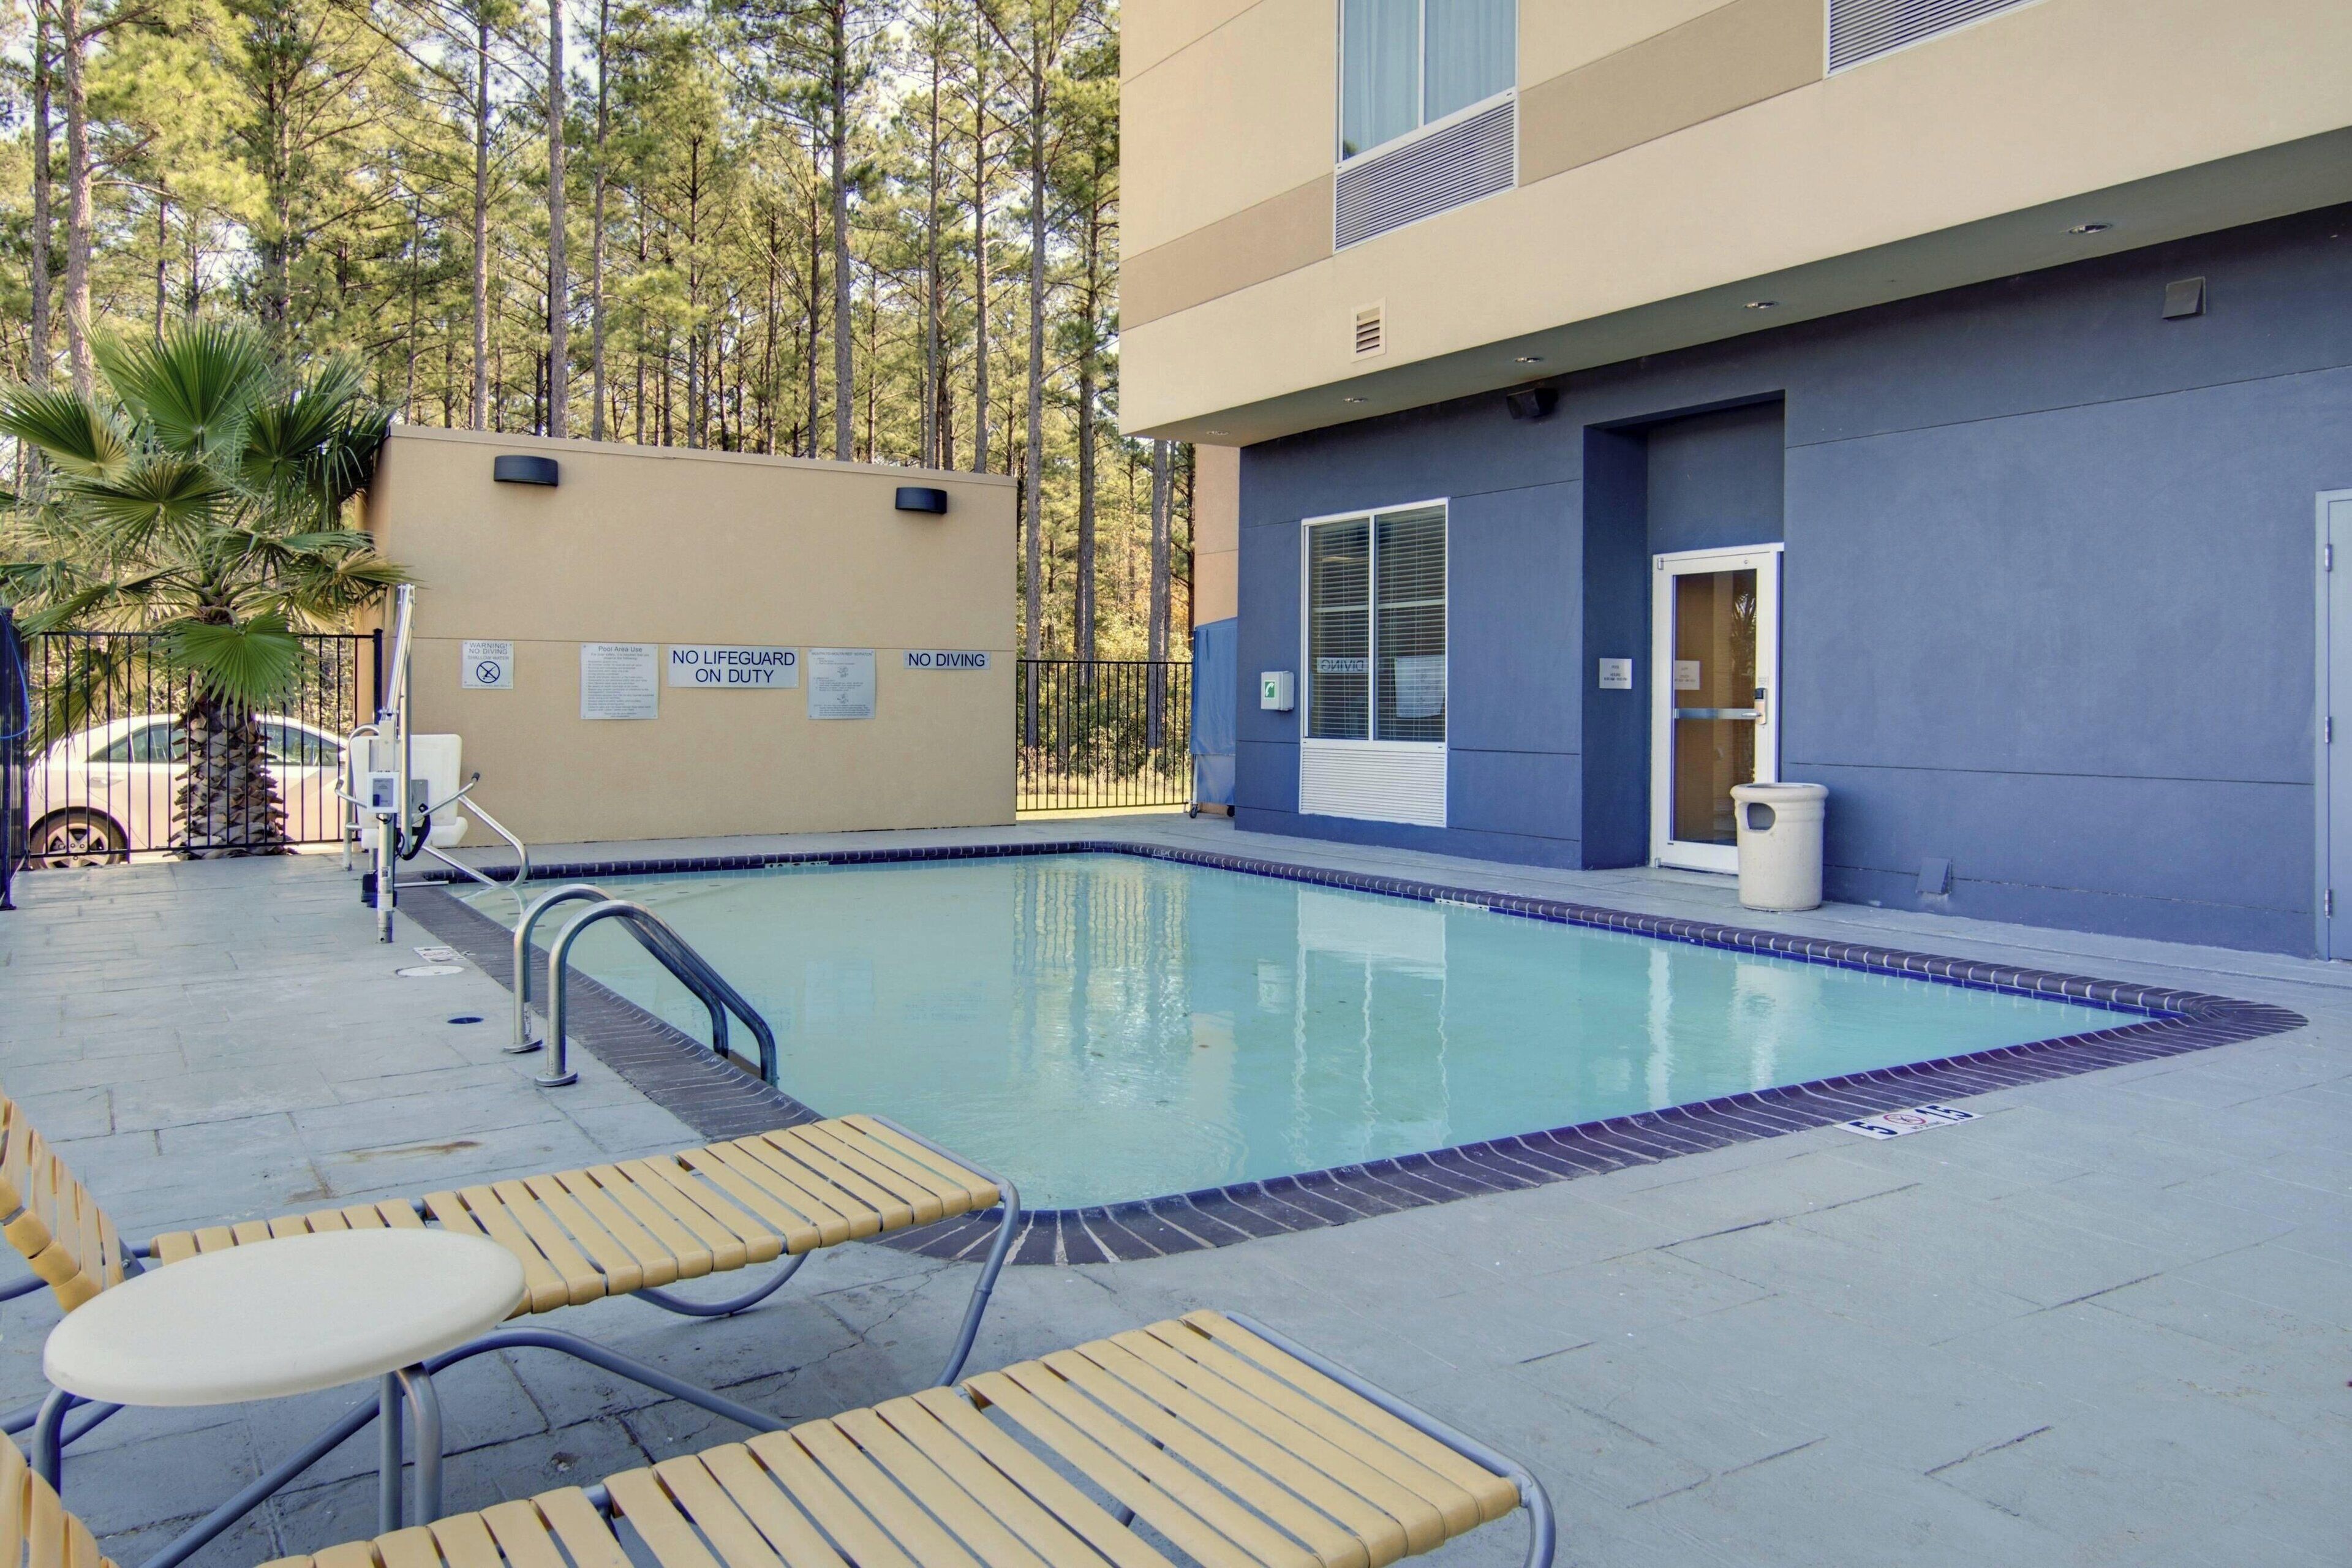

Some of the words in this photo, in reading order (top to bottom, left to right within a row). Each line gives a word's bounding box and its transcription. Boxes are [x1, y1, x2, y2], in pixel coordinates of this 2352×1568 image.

[673, 650, 698, 664] NO
[704, 651, 795, 665] LIFEGUARD
[909, 654, 931, 666] NO
[937, 654, 985, 666] DIVING
[696, 669, 720, 682] ON
[729, 669, 774, 683] DUTY
[1849, 1121, 1898, 1135] 5
